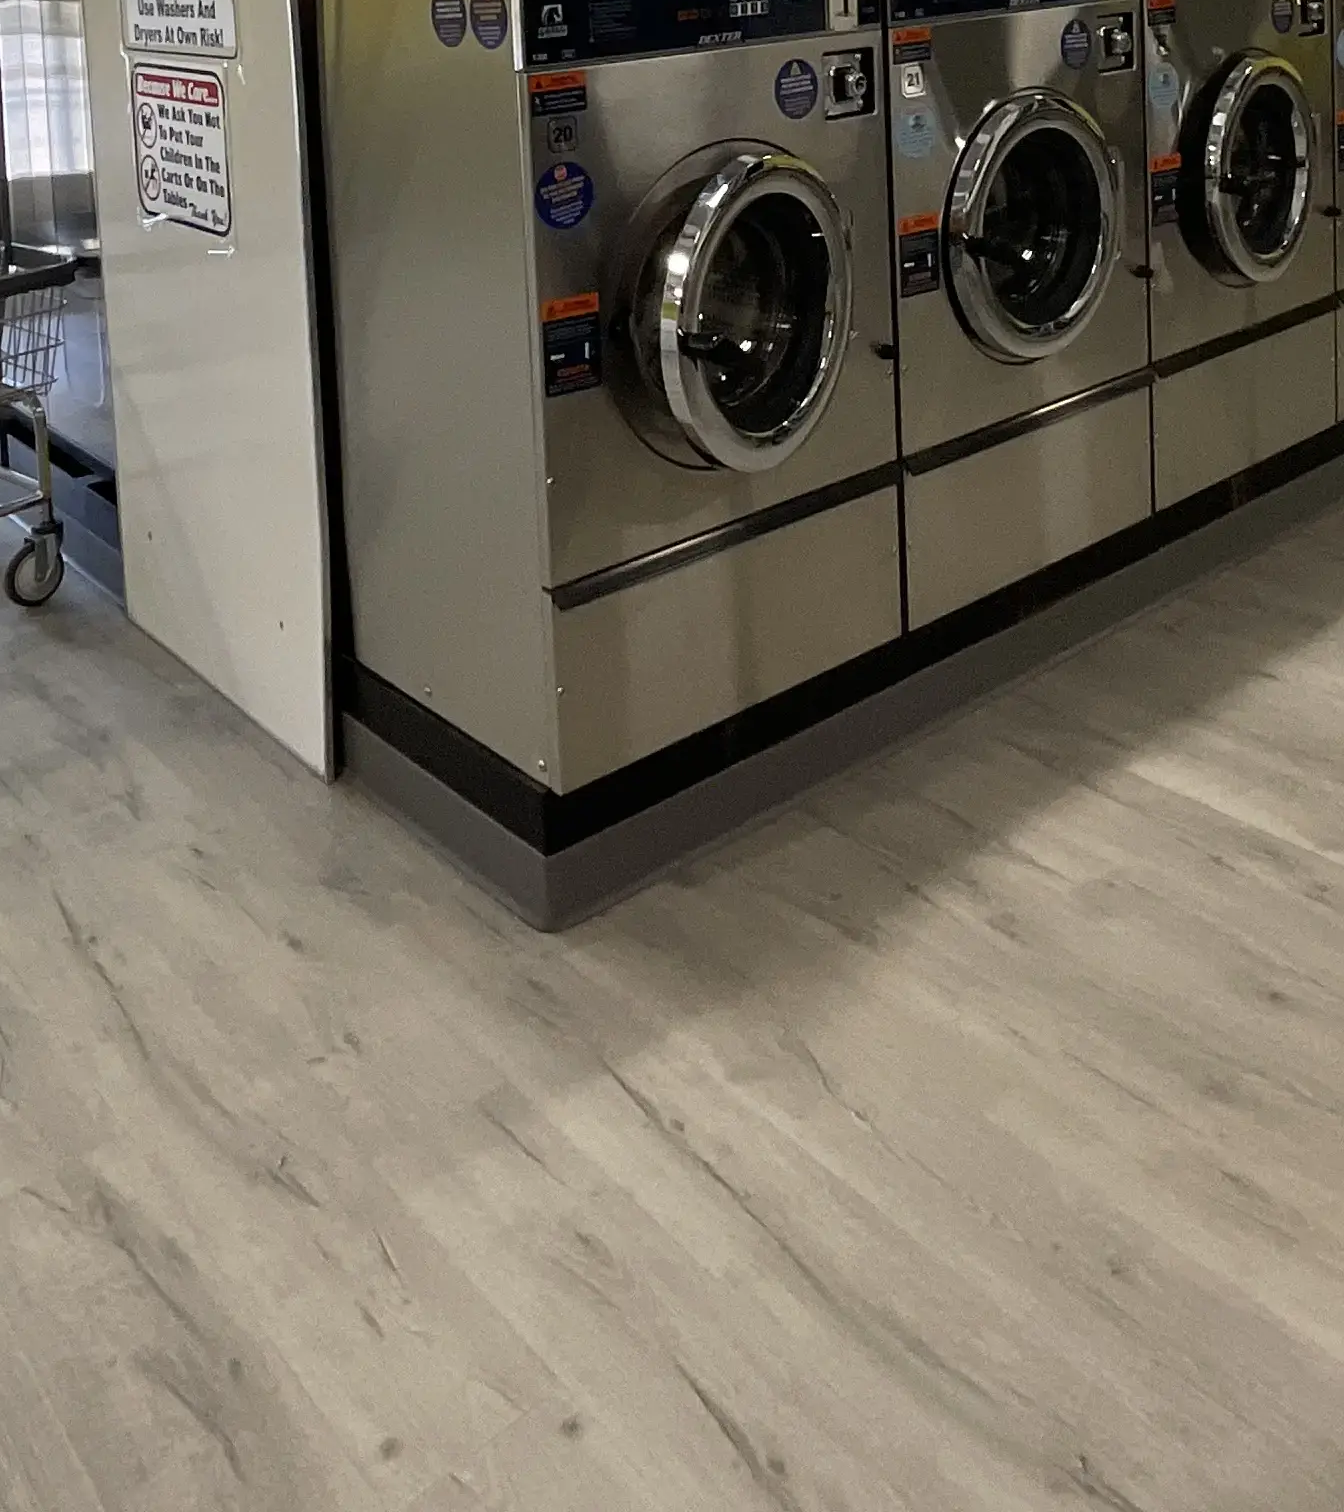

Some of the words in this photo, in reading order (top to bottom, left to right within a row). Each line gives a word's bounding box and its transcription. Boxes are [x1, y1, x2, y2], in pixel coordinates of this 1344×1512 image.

[156, 0, 194, 18] Washers
[198, 0, 215, 19] And
[134, 23, 162, 47] Dryers
[165, 25, 175, 44] At
[177, 26, 197, 45] Own
[200, 28, 224, 48] Risk!
[907, 72, 920, 87] 21
[157, 103, 169, 119] We
[172, 106, 186, 122] Ask
[188, 109, 203, 126] You
[205, 111, 221, 129] Not
[158, 125, 167, 140] To
[169, 126, 183, 143] Put
[185, 130, 203, 148] Your
[553, 125, 573, 144] 20
[160, 147, 194, 168] Children
[195, 154, 203, 170] In
[205, 155, 221, 174] The
[161, 168, 182, 187] Carts
[184, 173, 194, 189] Or
[197, 176, 208, 193] On
[210, 178, 225, 198] The
[162, 188, 187, 209] Tables
